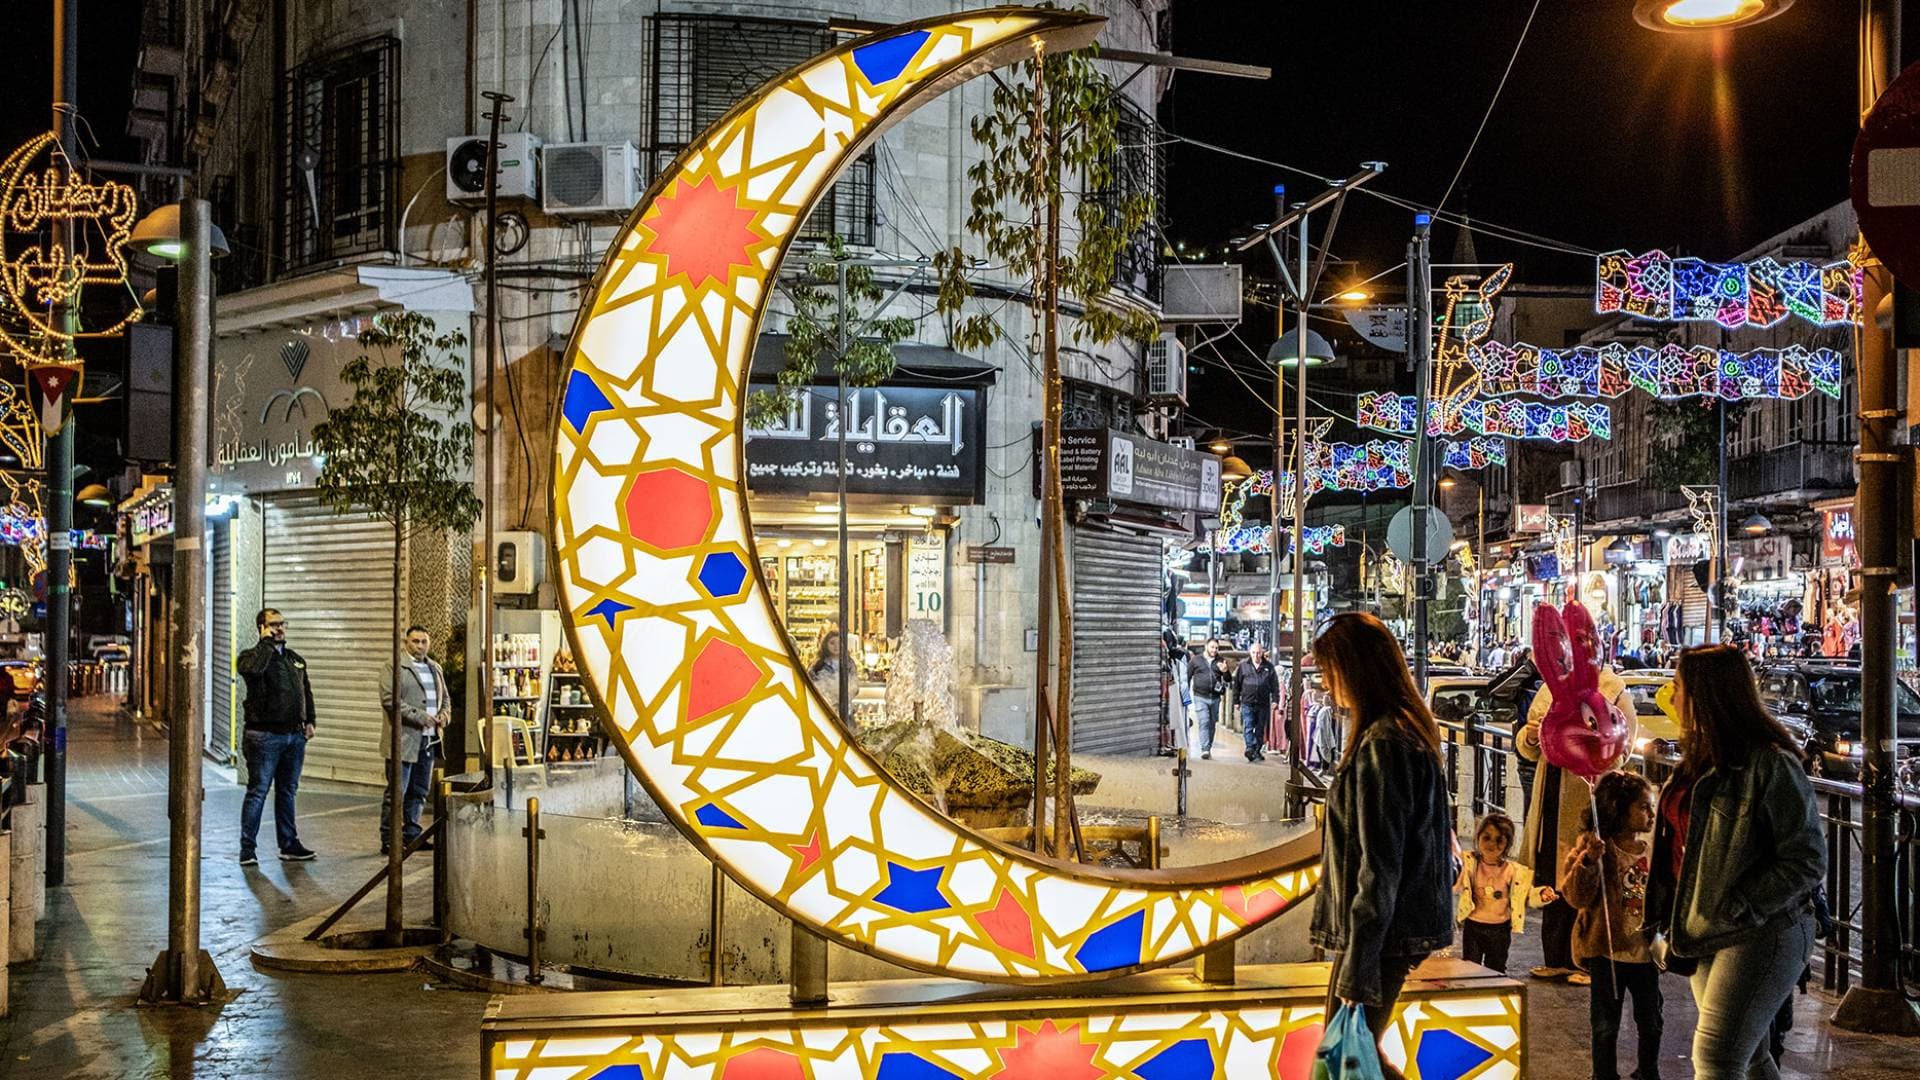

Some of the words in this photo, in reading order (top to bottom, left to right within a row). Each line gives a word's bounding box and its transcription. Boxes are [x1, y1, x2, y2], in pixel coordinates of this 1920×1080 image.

[12, 168, 137, 232] رمضان
[16, 230, 131, 304] كريم
[819, 391, 965, 455] العقايلة
[218, 438, 266, 470] العقايلة
[1067, 435, 1097, 445] Service
[1080, 448, 1101, 456] Battery
[1075, 456, 1099, 464] Printing
